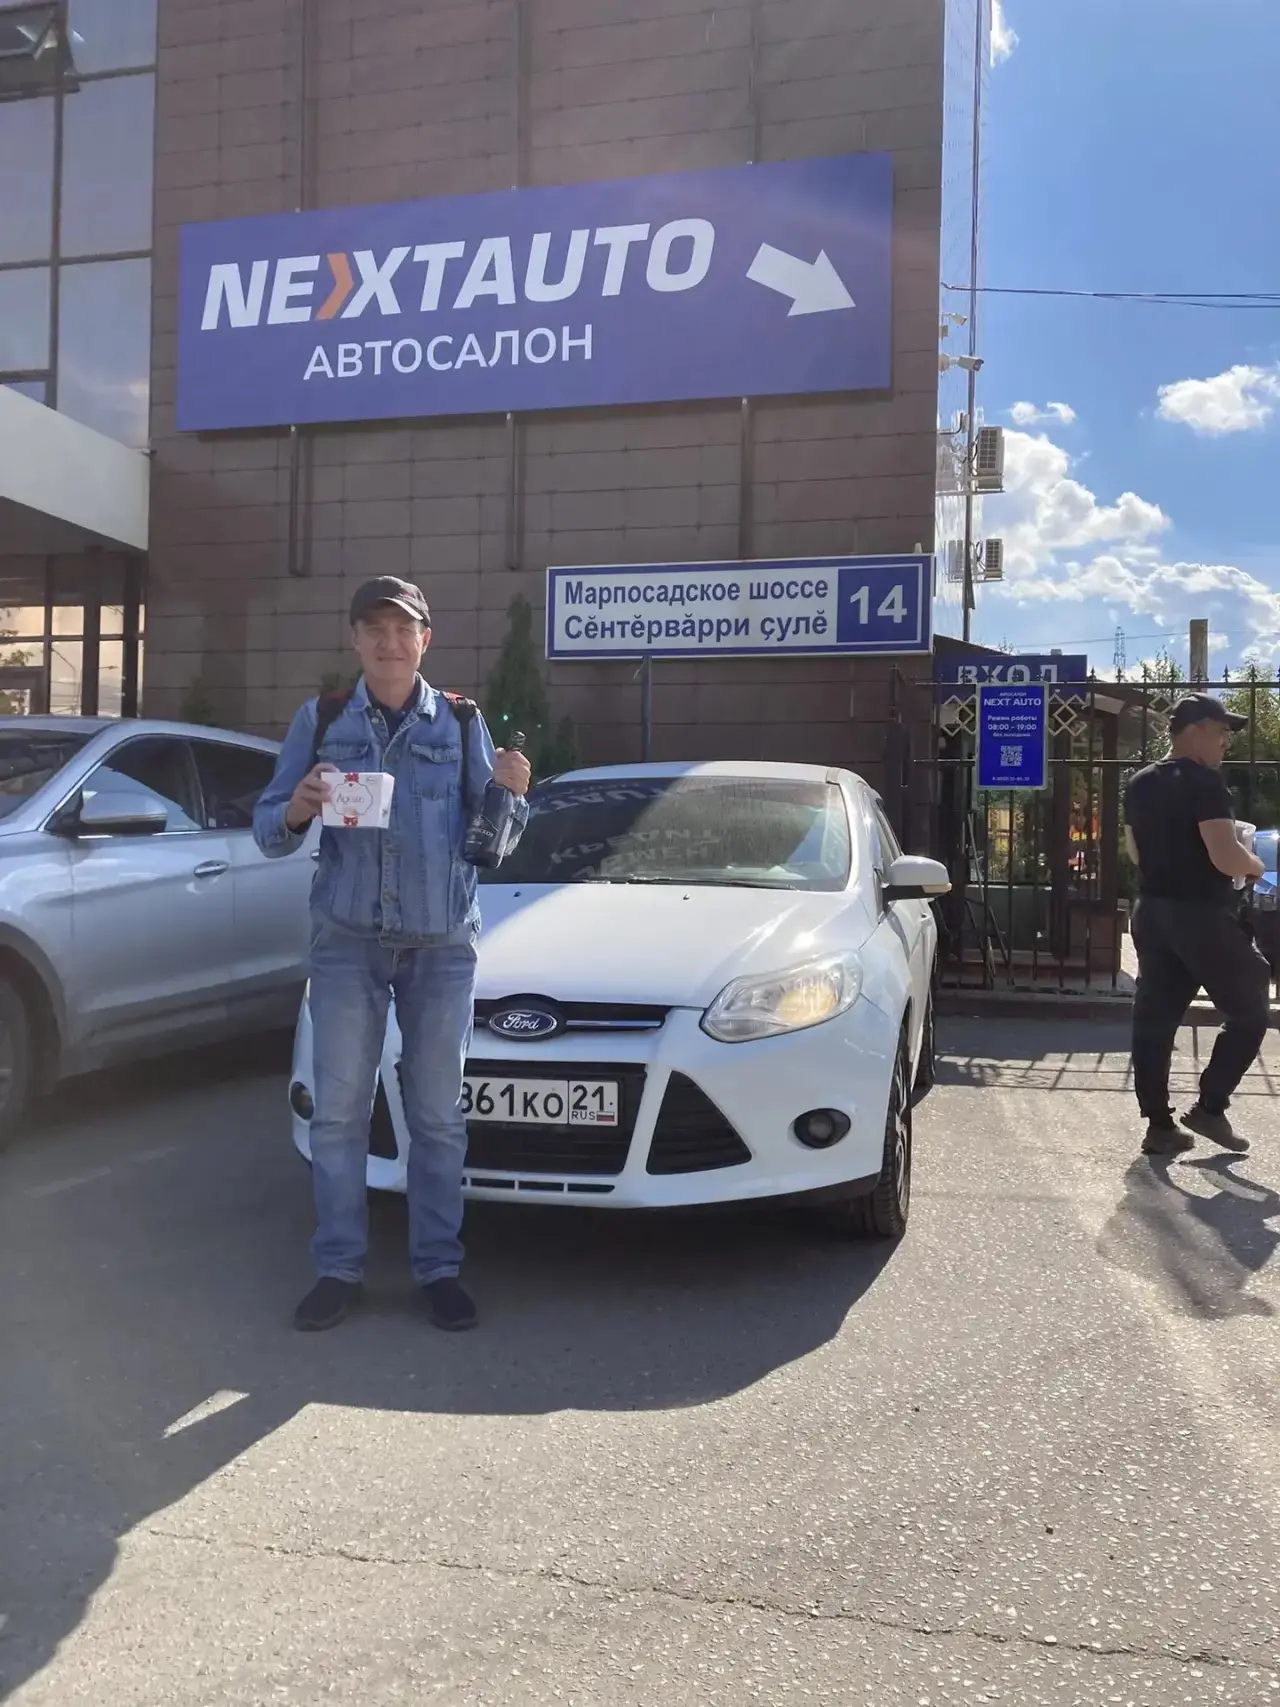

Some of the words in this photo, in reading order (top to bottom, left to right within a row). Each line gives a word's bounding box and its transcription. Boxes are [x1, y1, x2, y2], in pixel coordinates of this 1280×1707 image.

[303, 323, 594, 381] АВТОСАЛОН
[564, 580, 740, 610] Марпосадское
[749, 578, 829, 600] шоссе
[849, 584, 907, 625] 14
[983, 698, 1011, 706] NEXT
[1012, 698, 1042, 706] AUTO
[1011, 714, 1038, 722] работы
[503, 1012, 540, 1030] Ford
[572, 1084, 605, 1112] 21
[571, 1110, 596, 1121] RUS
